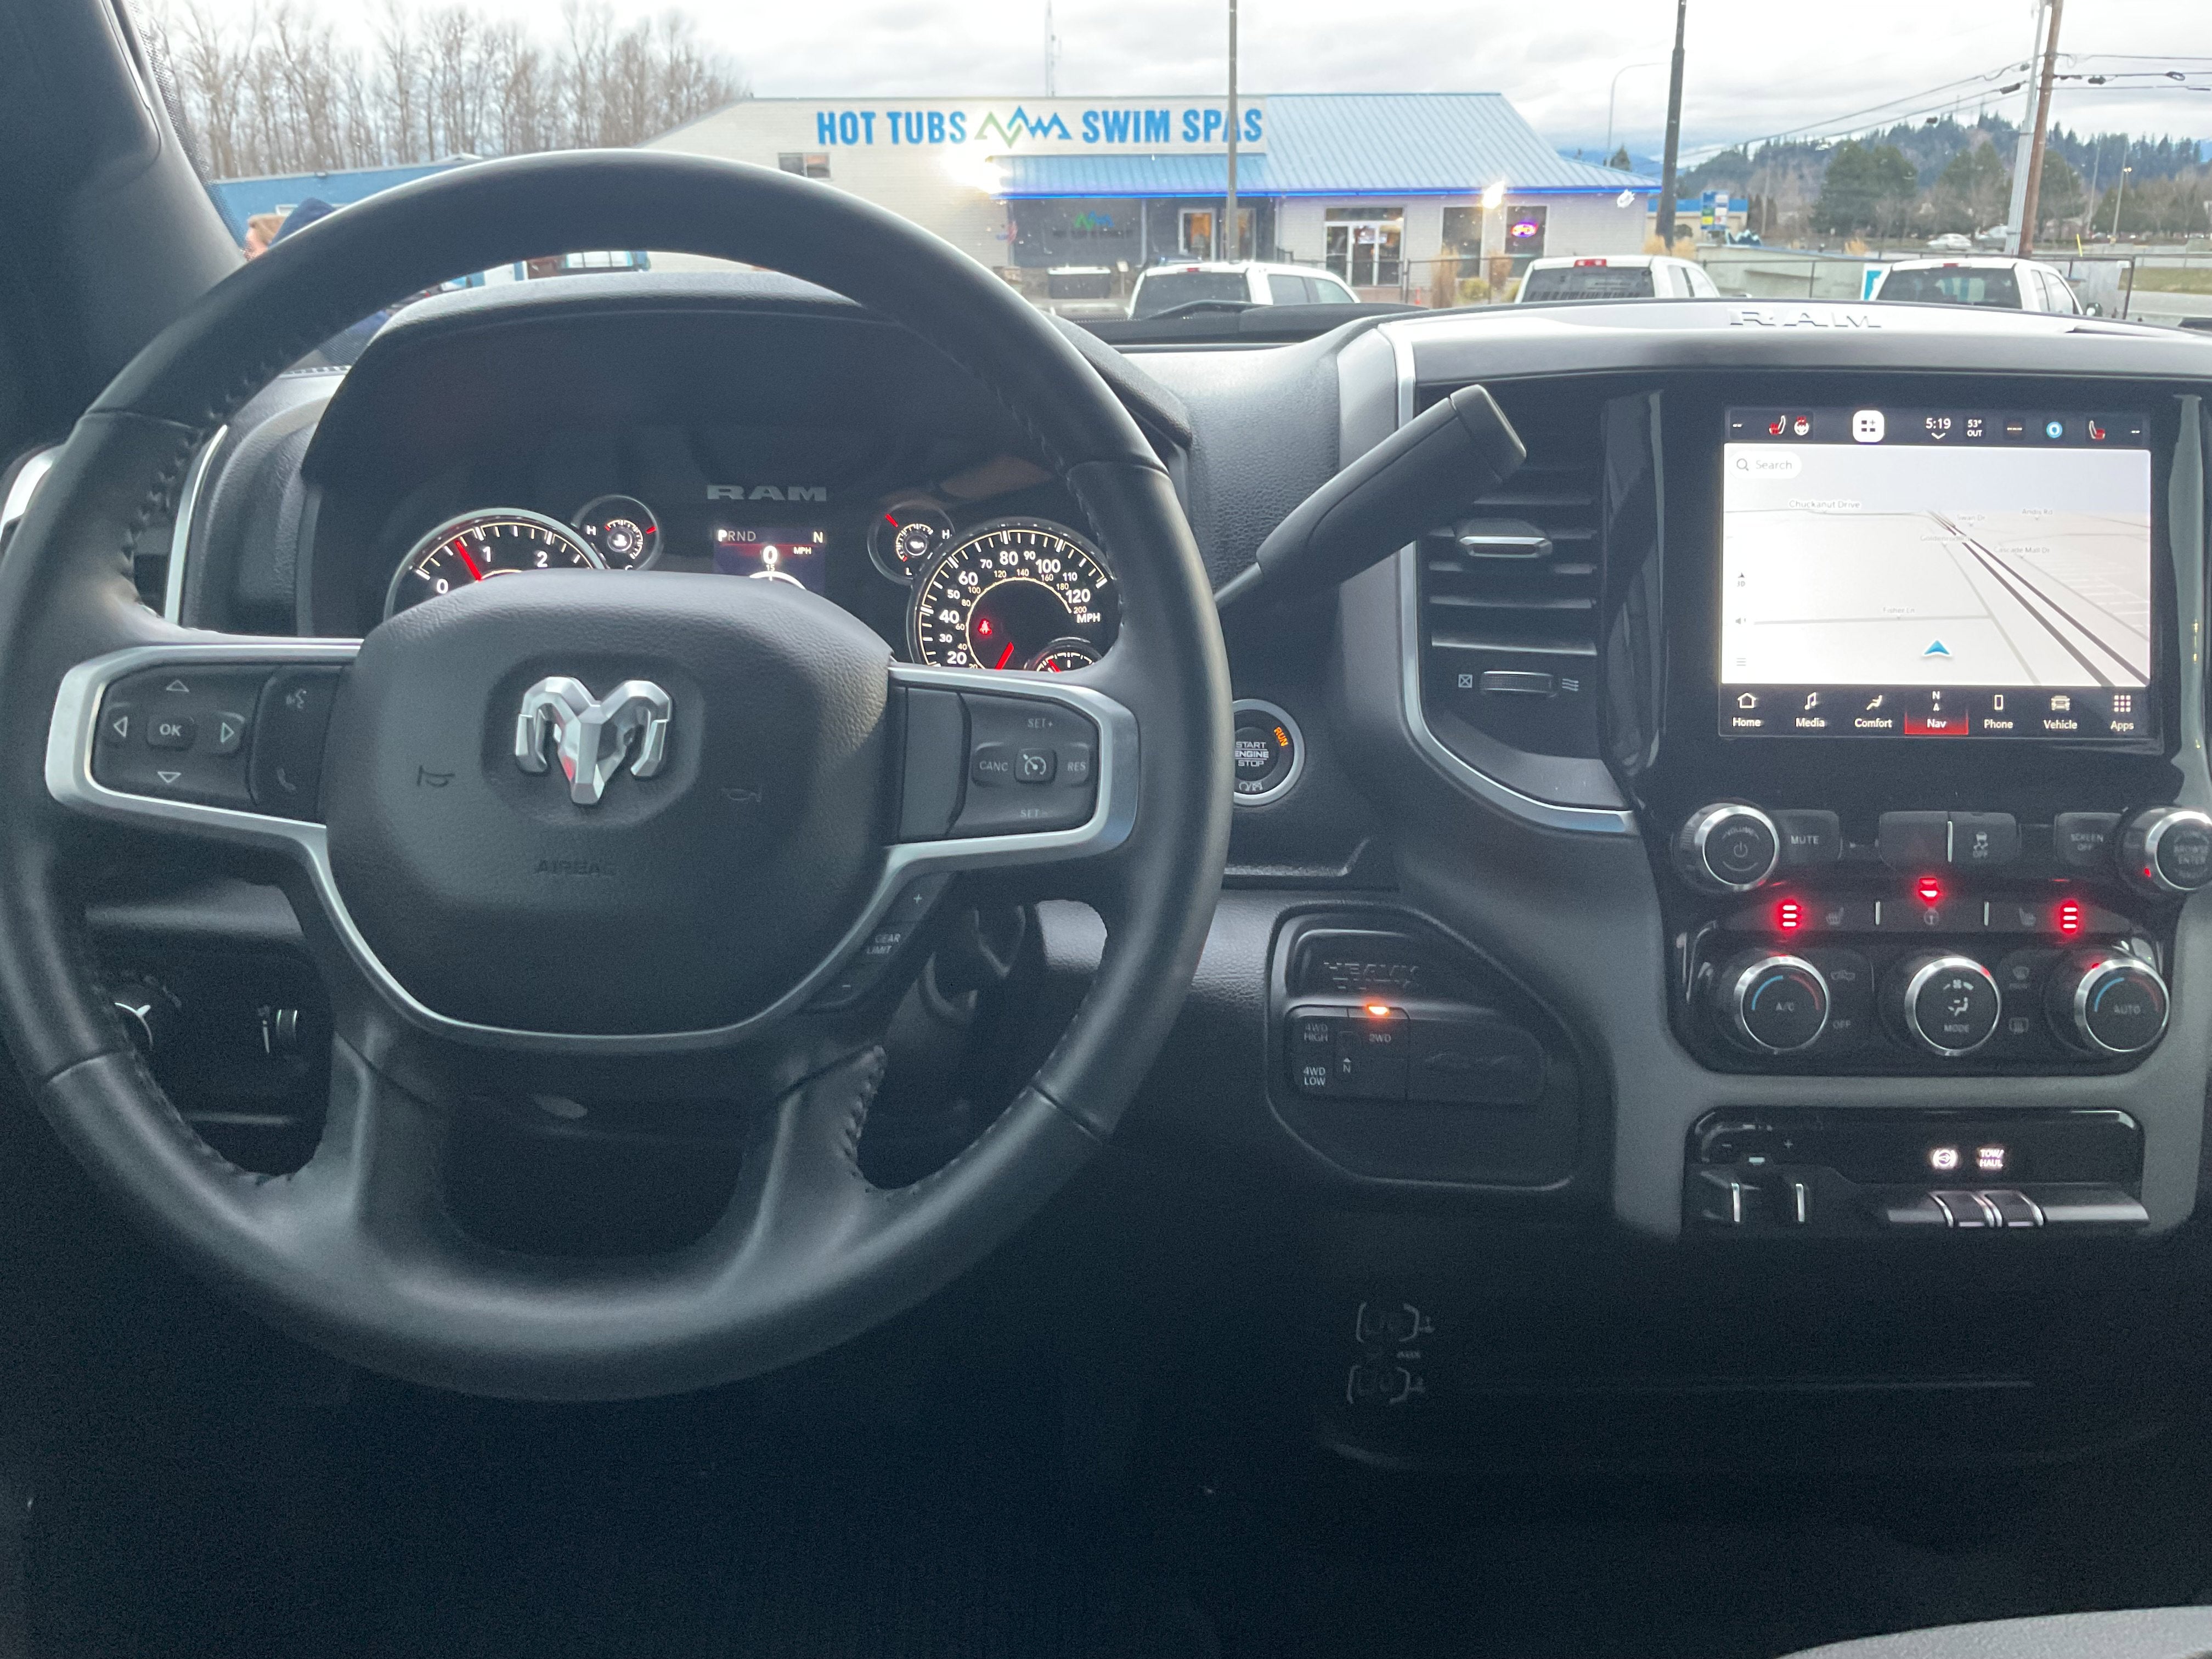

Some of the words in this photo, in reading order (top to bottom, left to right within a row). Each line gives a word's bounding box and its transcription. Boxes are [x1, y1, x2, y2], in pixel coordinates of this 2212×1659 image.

[817, 111, 876, 145] HOT
[887, 111, 966, 145] TUBS
[1082, 109, 1170, 143] SWIM
[1183, 108, 1262, 143] SPAS
[1730, 311, 1882, 328] RAM
[1926, 417, 1951, 429] 5:19
[1967, 419, 1982, 428] 53°
[1756, 460, 1792, 470] Search
[707, 485, 827, 501] RAM
[1788, 500, 1836, 509] Chuckanut
[586, 526, 596, 535] H
[942, 529, 950, 539] H
[813, 531, 823, 543] N
[483, 546, 491, 562] 1
[763, 546, 777, 565] 0
[793, 546, 811, 555] MPH
[537, 551, 548, 568] 2
[1000, 550, 1019, 566] 80
[1024, 551, 1035, 561] 90
[980, 558, 992, 569] 70
[1036, 558, 1061, 573] 100
[906, 567, 912, 576] L
[994, 569, 1007, 578] 120
[1017, 568, 1030, 577] 140
[958, 571, 978, 586] 60
[1041, 573, 1054, 582] 160
[1063, 572, 1078, 582] 110
[437, 580, 448, 594] 0
[968, 586, 981, 595] 100
[1056, 582, 1069, 591] 180
[947, 589, 961, 600] 50
[1065, 589, 1091, 604] 120
[939, 610, 960, 624] 40
[1076, 613, 1101, 624] MPH
[939, 633, 953, 643] 30
[947, 651, 967, 665] 20
[1932, 691, 1940, 699] N
[1733, 718, 1761, 727] Home
[1796, 718, 1825, 728] Media
[1854, 718, 1892, 728] Comfort
[1927, 719, 1946, 729] Nav
[1984, 719, 2013, 729] Phone
[2044, 720, 2078, 730] Vehicle
[2111, 721, 2134, 731] Apps
[159, 724, 182, 737] OK
[1273, 726, 1289, 747] RUN
[979, 760, 1008, 772] CANC
[1067, 761, 1086, 771] RES
[1791, 834, 1820, 845] MUTE
[1775, 1002, 1795, 1012] A/C
[2114, 1005, 2141, 1014] AUTO
[1943, 1024, 1970, 1033] MODE
[1303, 1066, 1326, 1076] 4WD
[1342, 1063, 1351, 1073] N
[1304, 1077, 1326, 1086] LOW
[1979, 1159, 2004, 1167] HAUL
